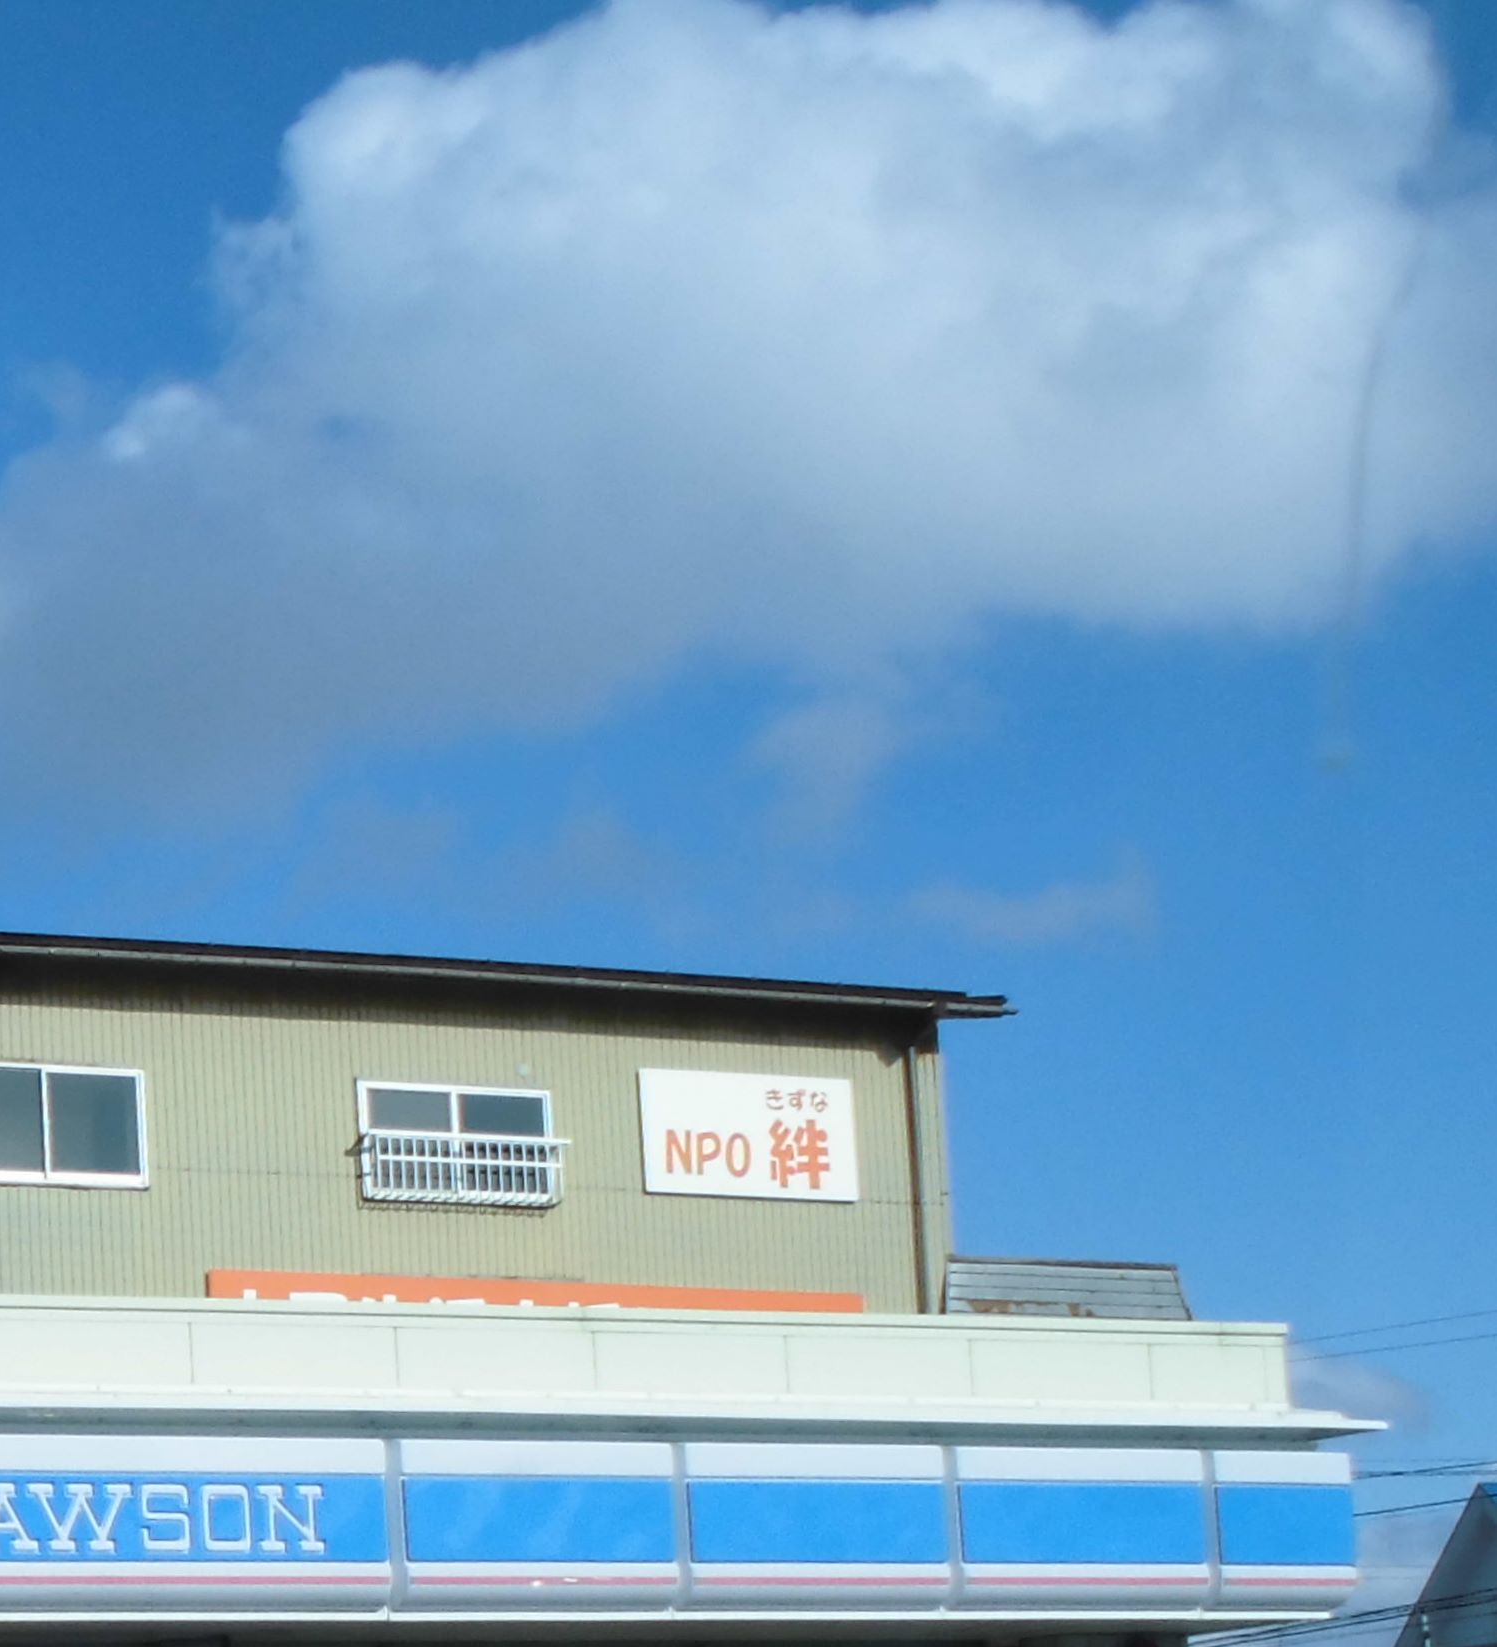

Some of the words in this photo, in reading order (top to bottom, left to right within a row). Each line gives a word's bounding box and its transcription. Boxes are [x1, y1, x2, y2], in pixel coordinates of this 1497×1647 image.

[765, 1089, 829, 1112] きずな
[664, 1128, 752, 1178] NPO
[768, 1118, 830, 1189] 絆
